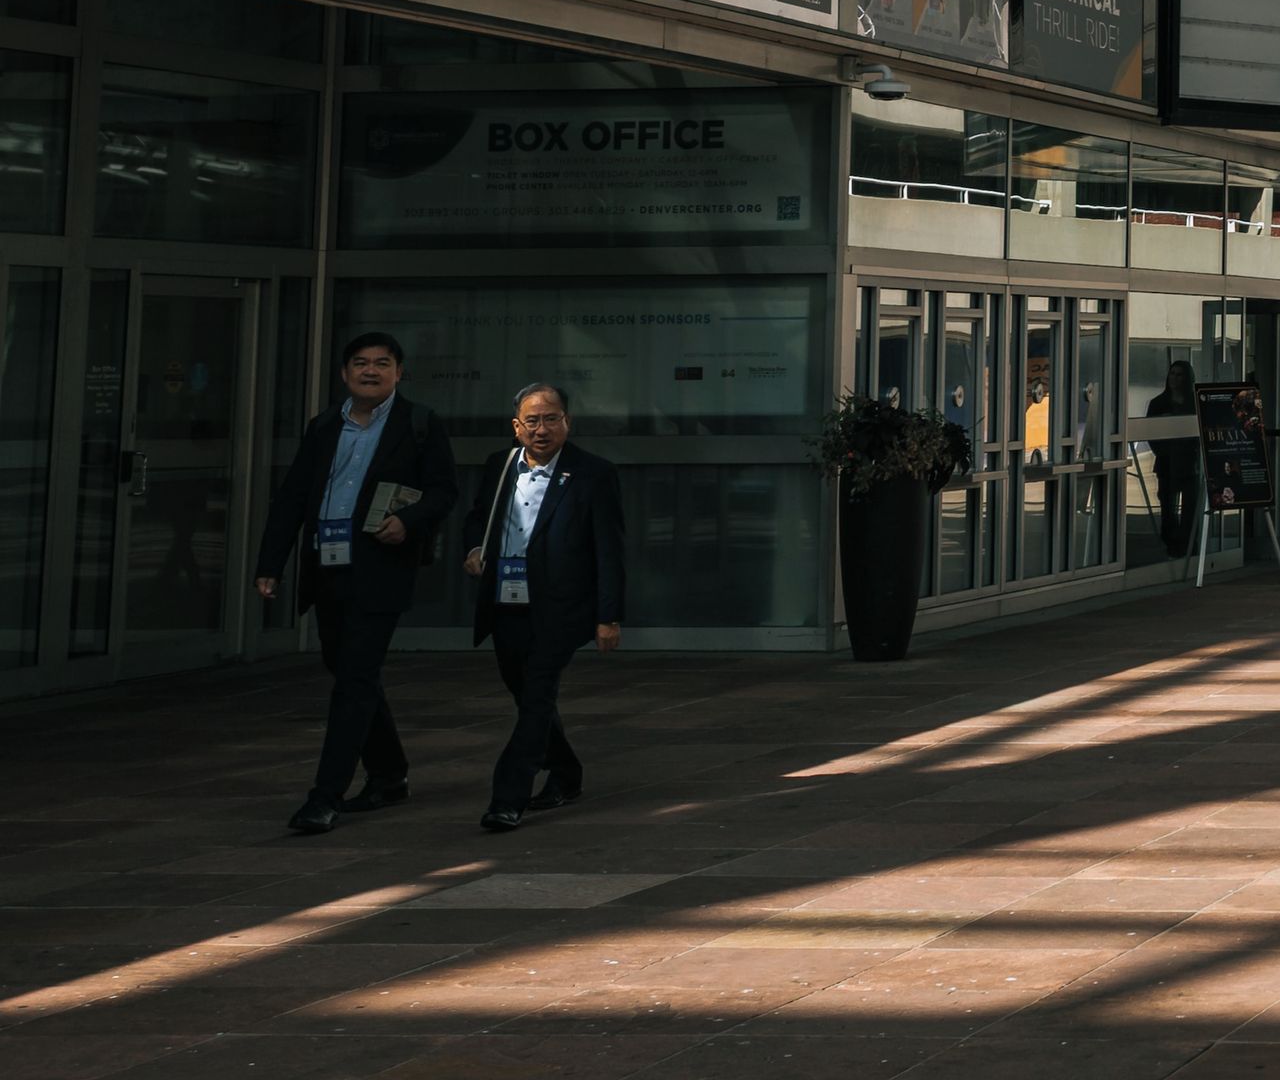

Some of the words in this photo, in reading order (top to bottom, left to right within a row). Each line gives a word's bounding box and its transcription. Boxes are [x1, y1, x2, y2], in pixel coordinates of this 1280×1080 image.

[1033, 4, 1082, 43] THRILL
[1086, 17, 1120, 53] RIDE!
[487, 122, 569, 152] BOX
[581, 120, 725, 152] OFFICE
[487, 171, 518, 180] TICKET
[521, 171, 560, 179] WINDOW
[590, 170, 629, 178] TUESDAY
[486, 183, 517, 191] PHONE
[519, 183, 554, 191] CENTER
[639, 204, 762, 215] DENVERCENTER.ORG
[447, 315, 491, 327] THANK
[496, 315, 524, 327] YOU
[528, 316, 545, 327] TO
[550, 315, 578, 326] OUR
[581, 314, 635, 325] SEASON
[639, 313, 712, 325] SPONSORS
[1208, 428, 1248, 442] BRAIN
